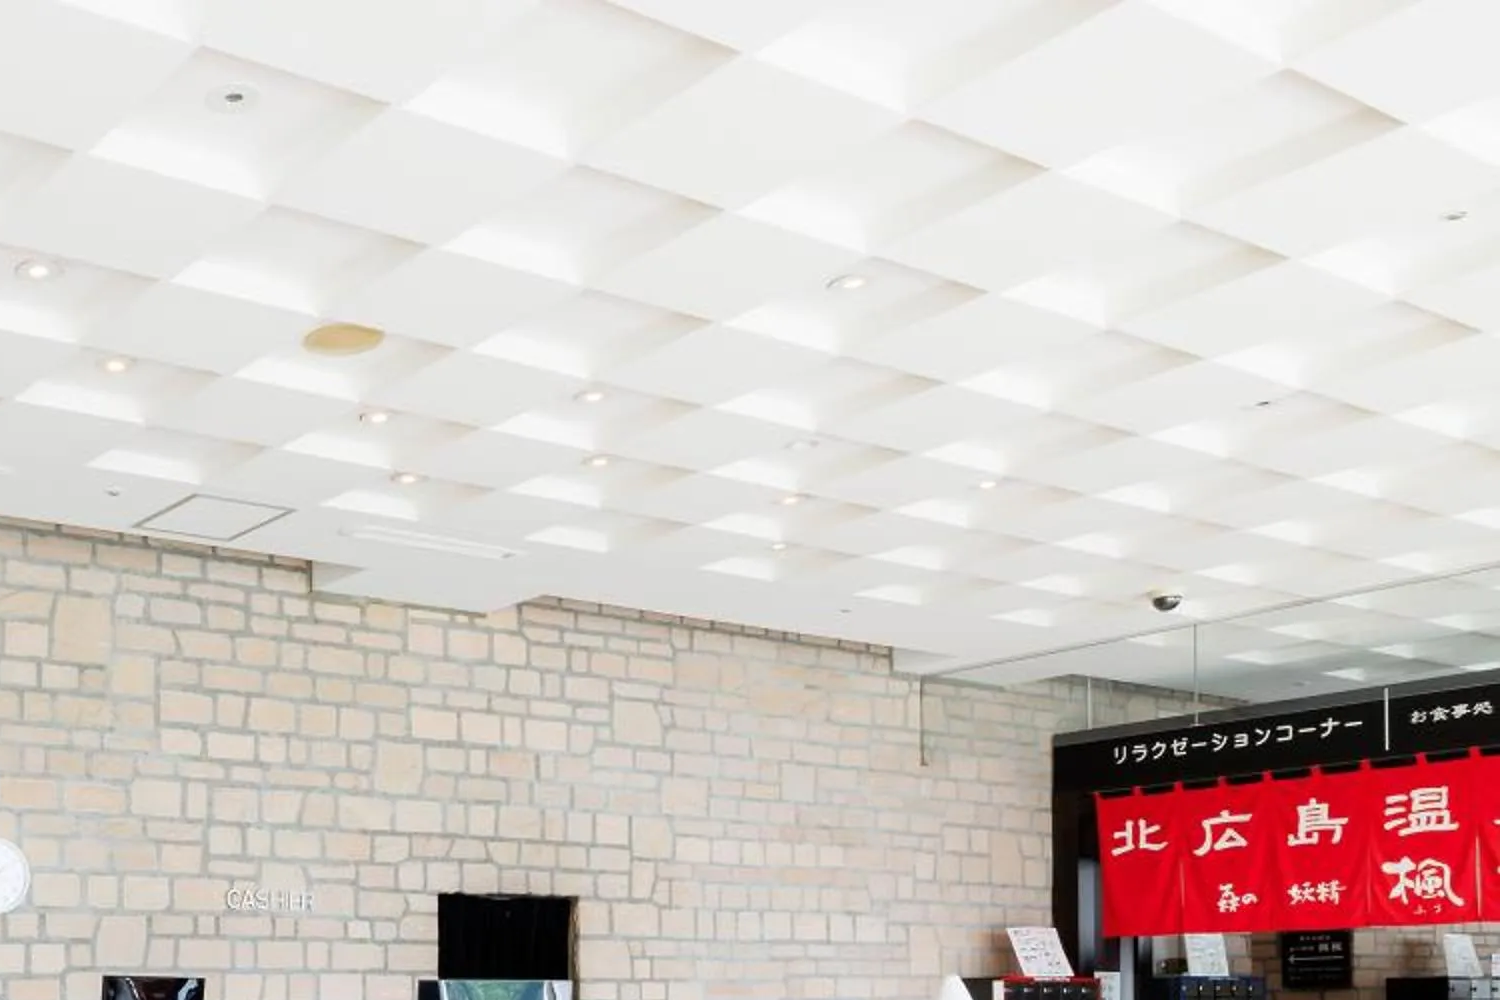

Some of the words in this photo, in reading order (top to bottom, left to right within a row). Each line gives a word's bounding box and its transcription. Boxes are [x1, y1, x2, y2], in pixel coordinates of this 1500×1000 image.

[1410, 701, 1494, 724] お食事処
[1113, 717, 1364, 765] リラクゼーションコーナー
[1111, 786, 1500, 857] 北広島温
